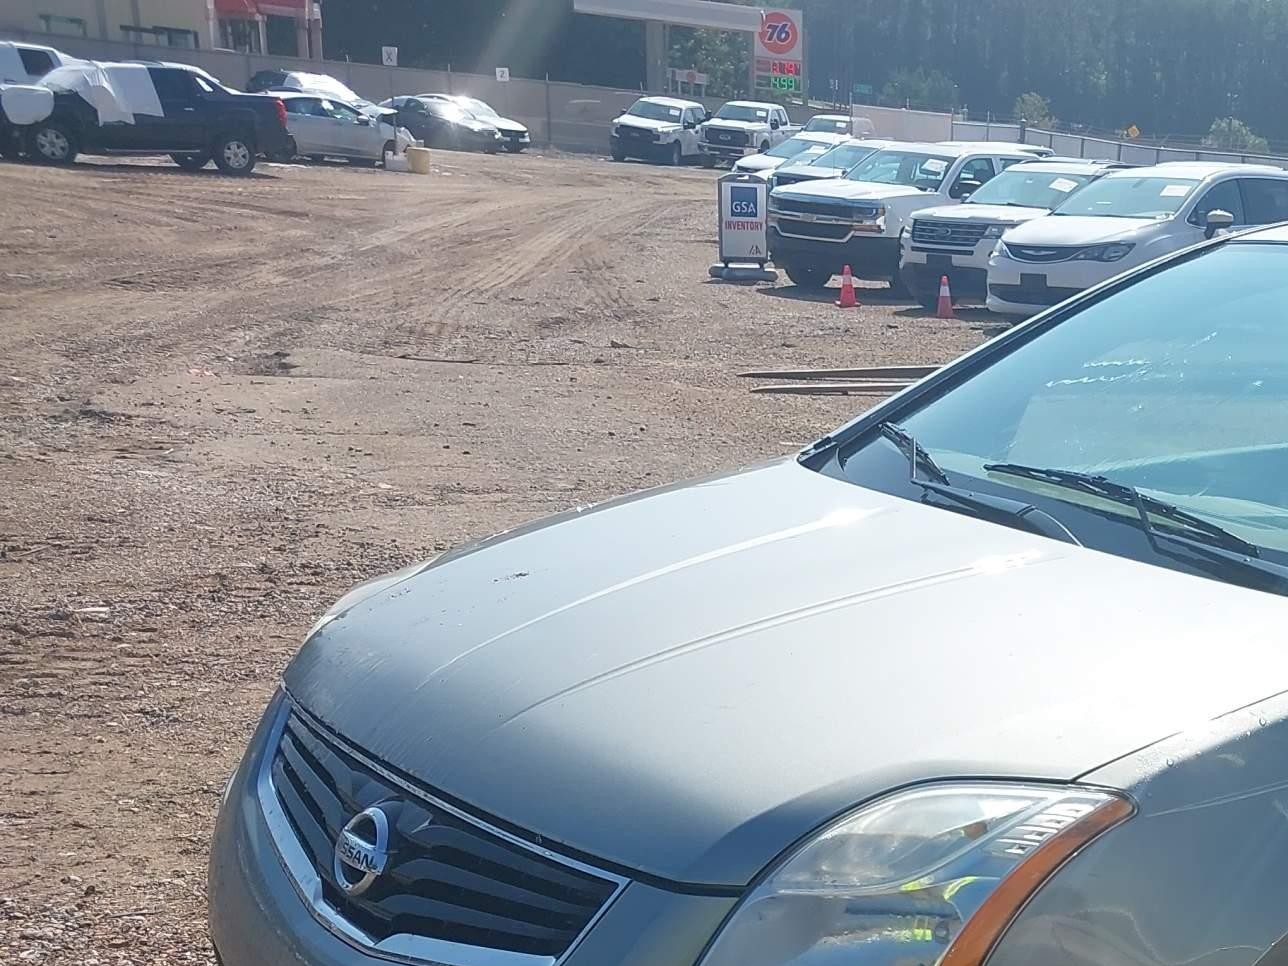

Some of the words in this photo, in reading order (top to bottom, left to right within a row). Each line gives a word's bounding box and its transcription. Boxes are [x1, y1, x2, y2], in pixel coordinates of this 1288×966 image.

[764, 22, 792, 44] 76
[732, 201, 756, 213] GSA
[725, 220, 763, 231] INVENTORY
